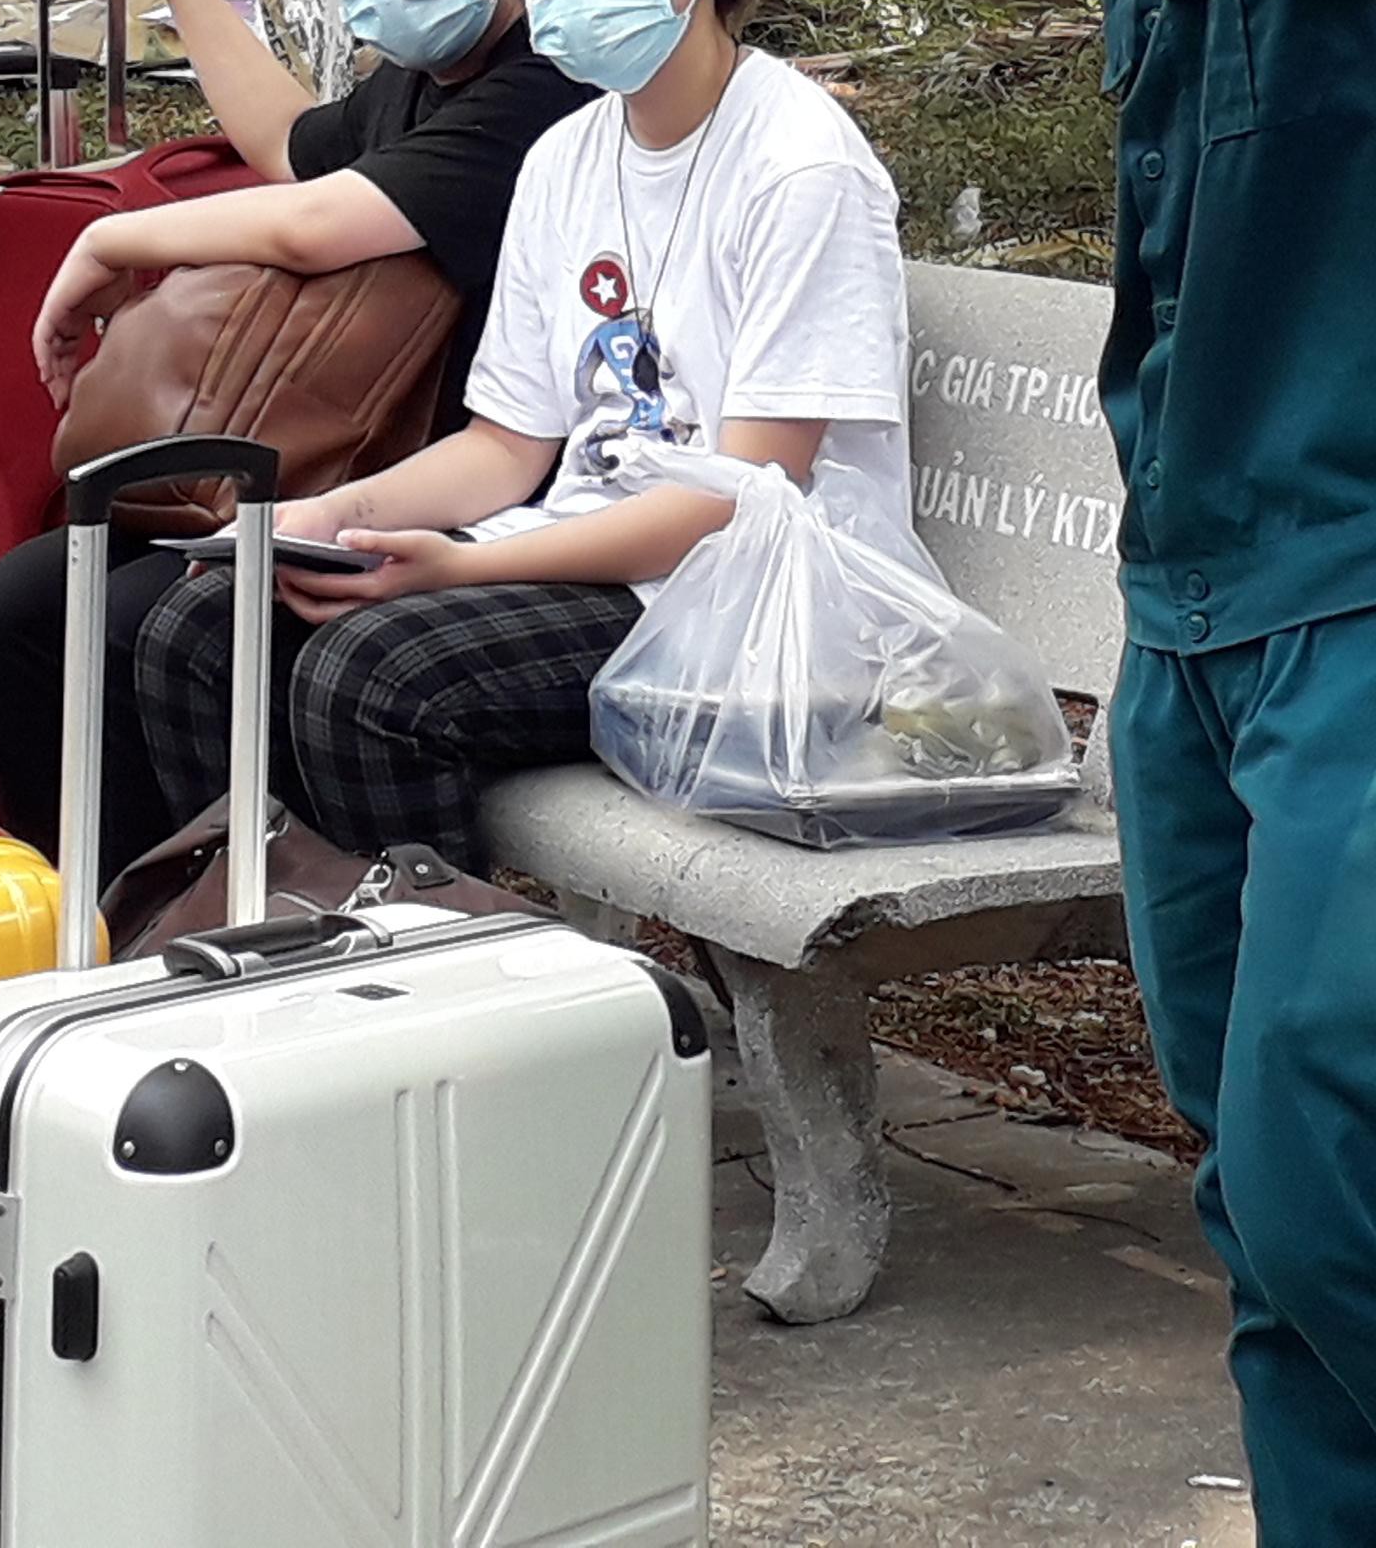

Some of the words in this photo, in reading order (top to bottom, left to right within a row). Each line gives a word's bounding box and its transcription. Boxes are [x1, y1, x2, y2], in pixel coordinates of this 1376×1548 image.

[1007, 363, 1108, 429] TP.HC
[911, 449, 991, 528] UẢN
[995, 472, 1048, 540] LÝ
